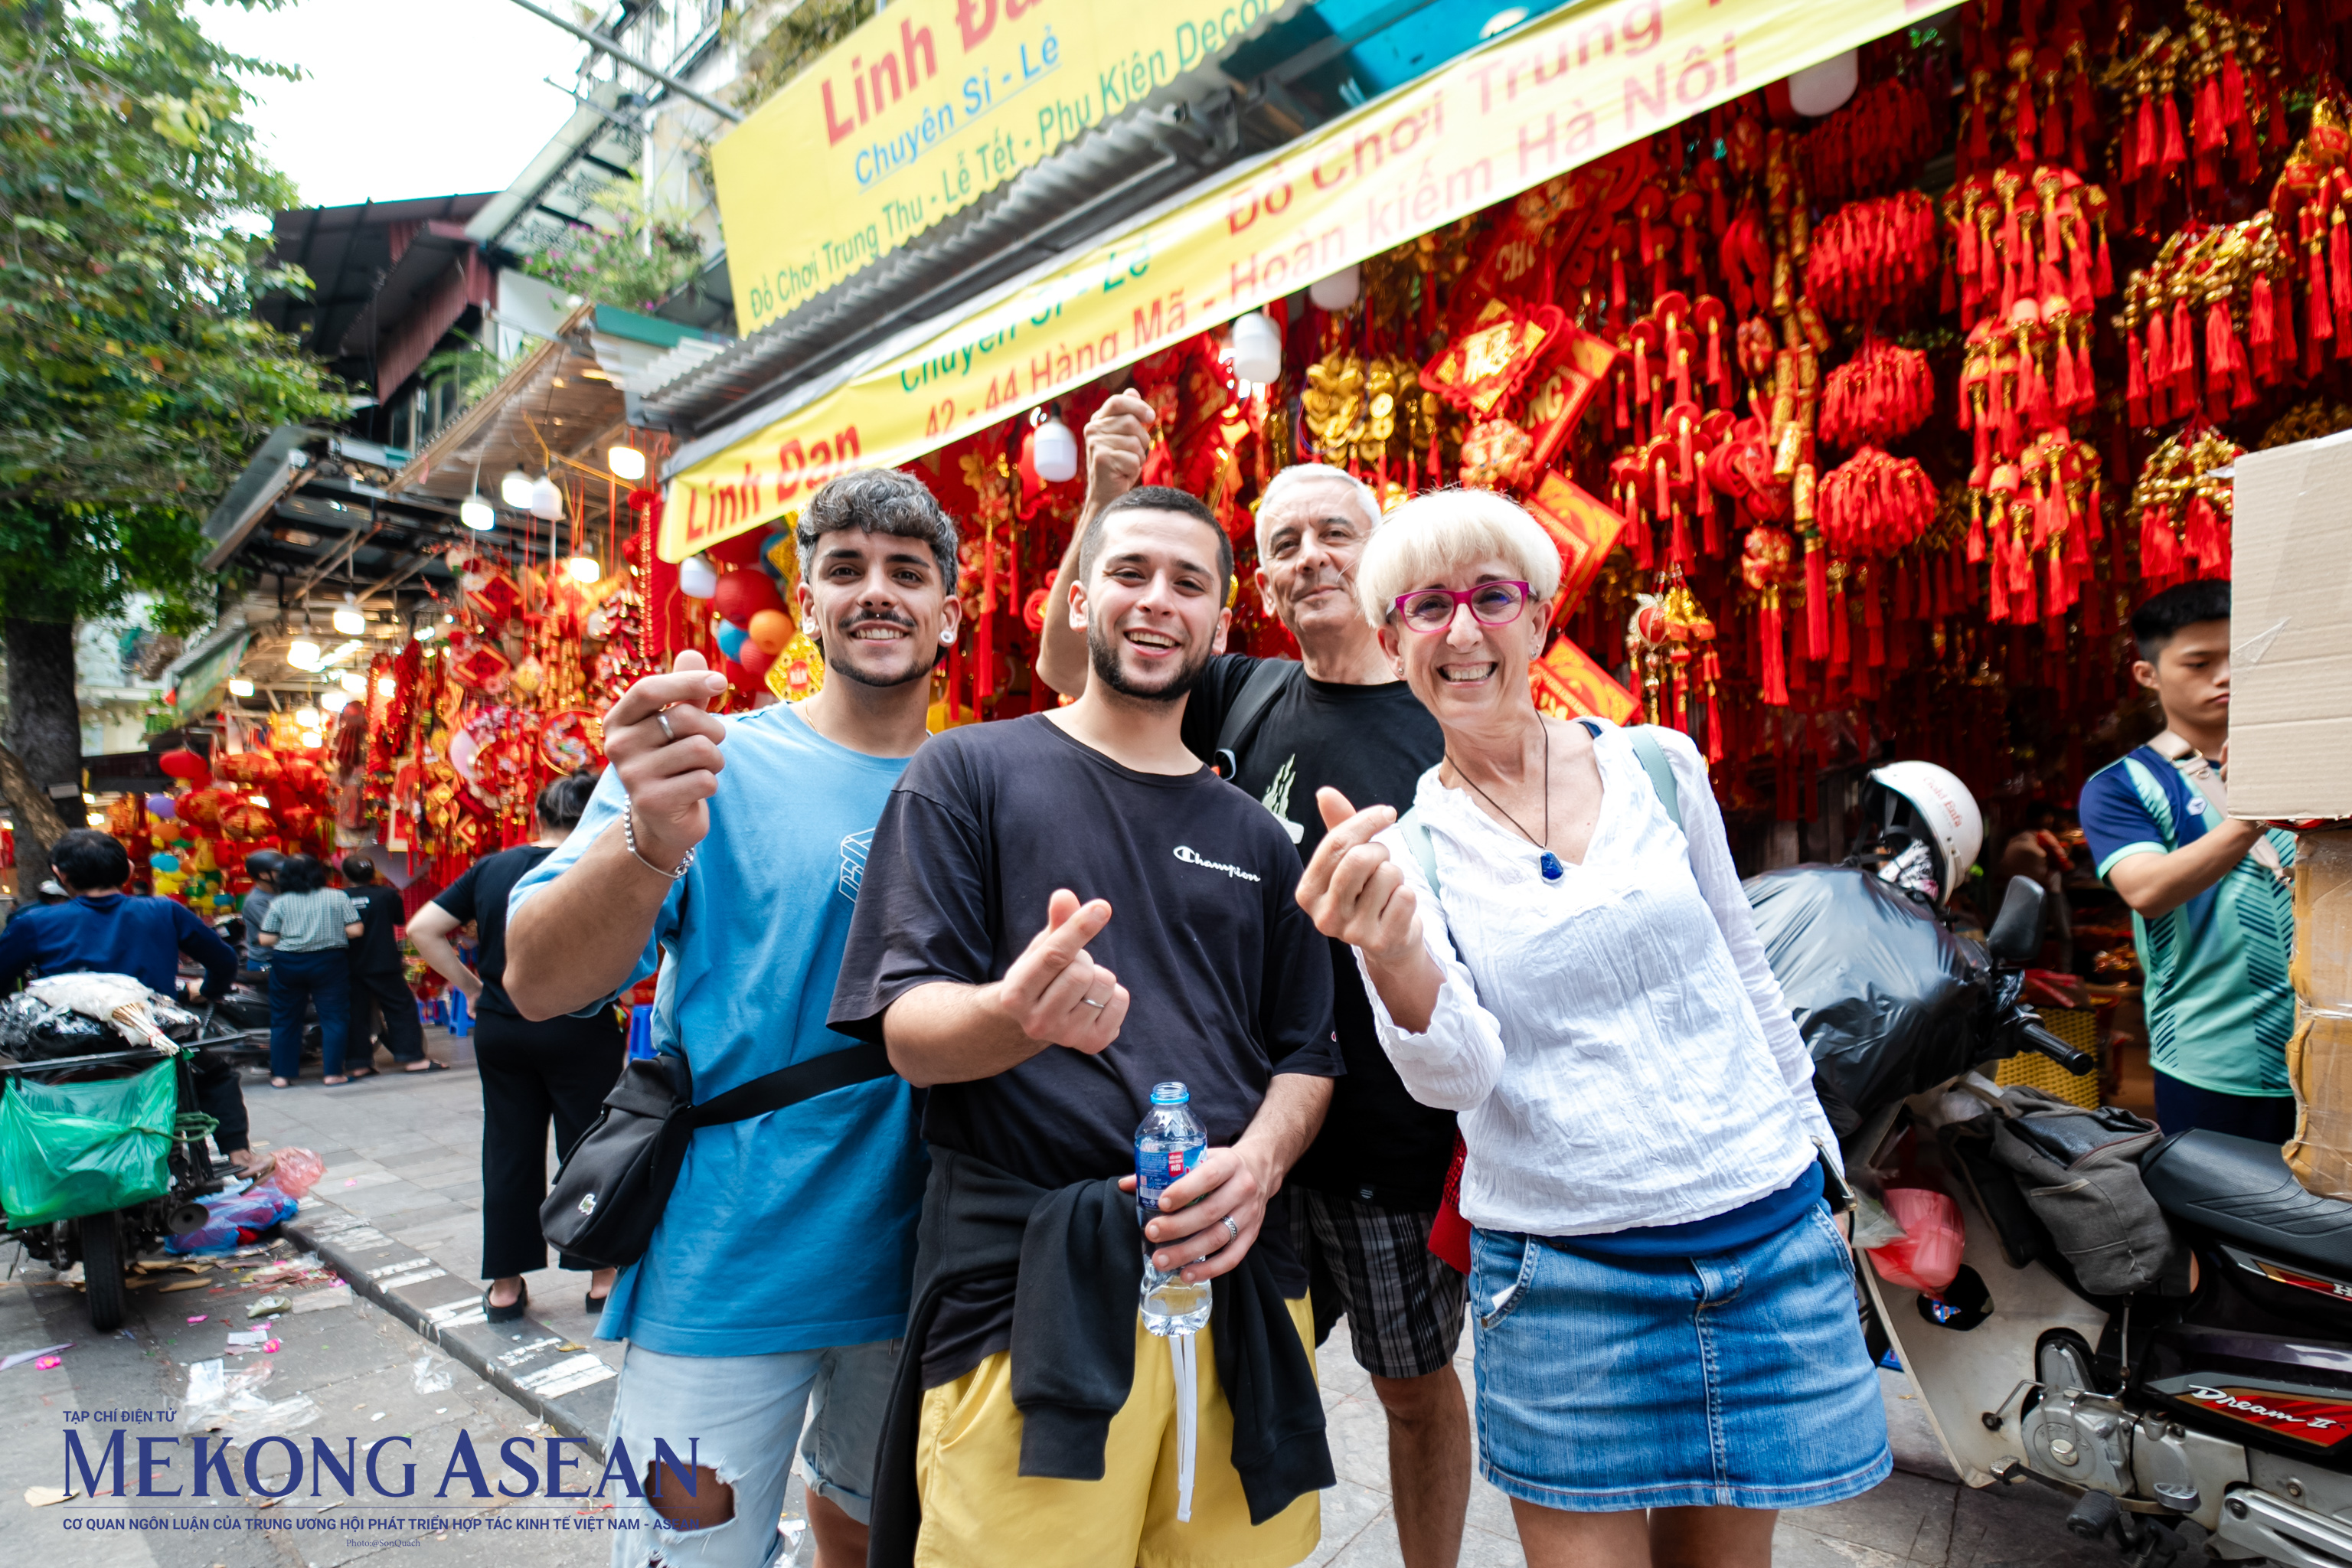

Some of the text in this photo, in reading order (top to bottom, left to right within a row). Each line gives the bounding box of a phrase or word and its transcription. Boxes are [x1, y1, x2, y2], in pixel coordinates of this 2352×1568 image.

[822, 17, 938, 148] Linh
[855, 24, 1060, 185] Chuyên Sỉ - Lẻ
[1312, 90, 1443, 191] Chơi
[1468, 0, 1663, 116] Trung
[750, 274, 773, 320] Đồ
[777, 251, 819, 303] Chơi
[822, 221, 879, 276] Trung
[882, 195, 924, 238] Thu
[975, 126, 1016, 183] Tết
[926, 398, 956, 439] 42
[985, 368, 1019, 413] 44
[1133, 287, 1187, 349] Mã
[1518, 100, 1596, 177] Hà
[686, 461, 761, 544] Linh
[1173, 845, 1261, 882] Champion
[2188, 1384, 2308, 1423] Dream
